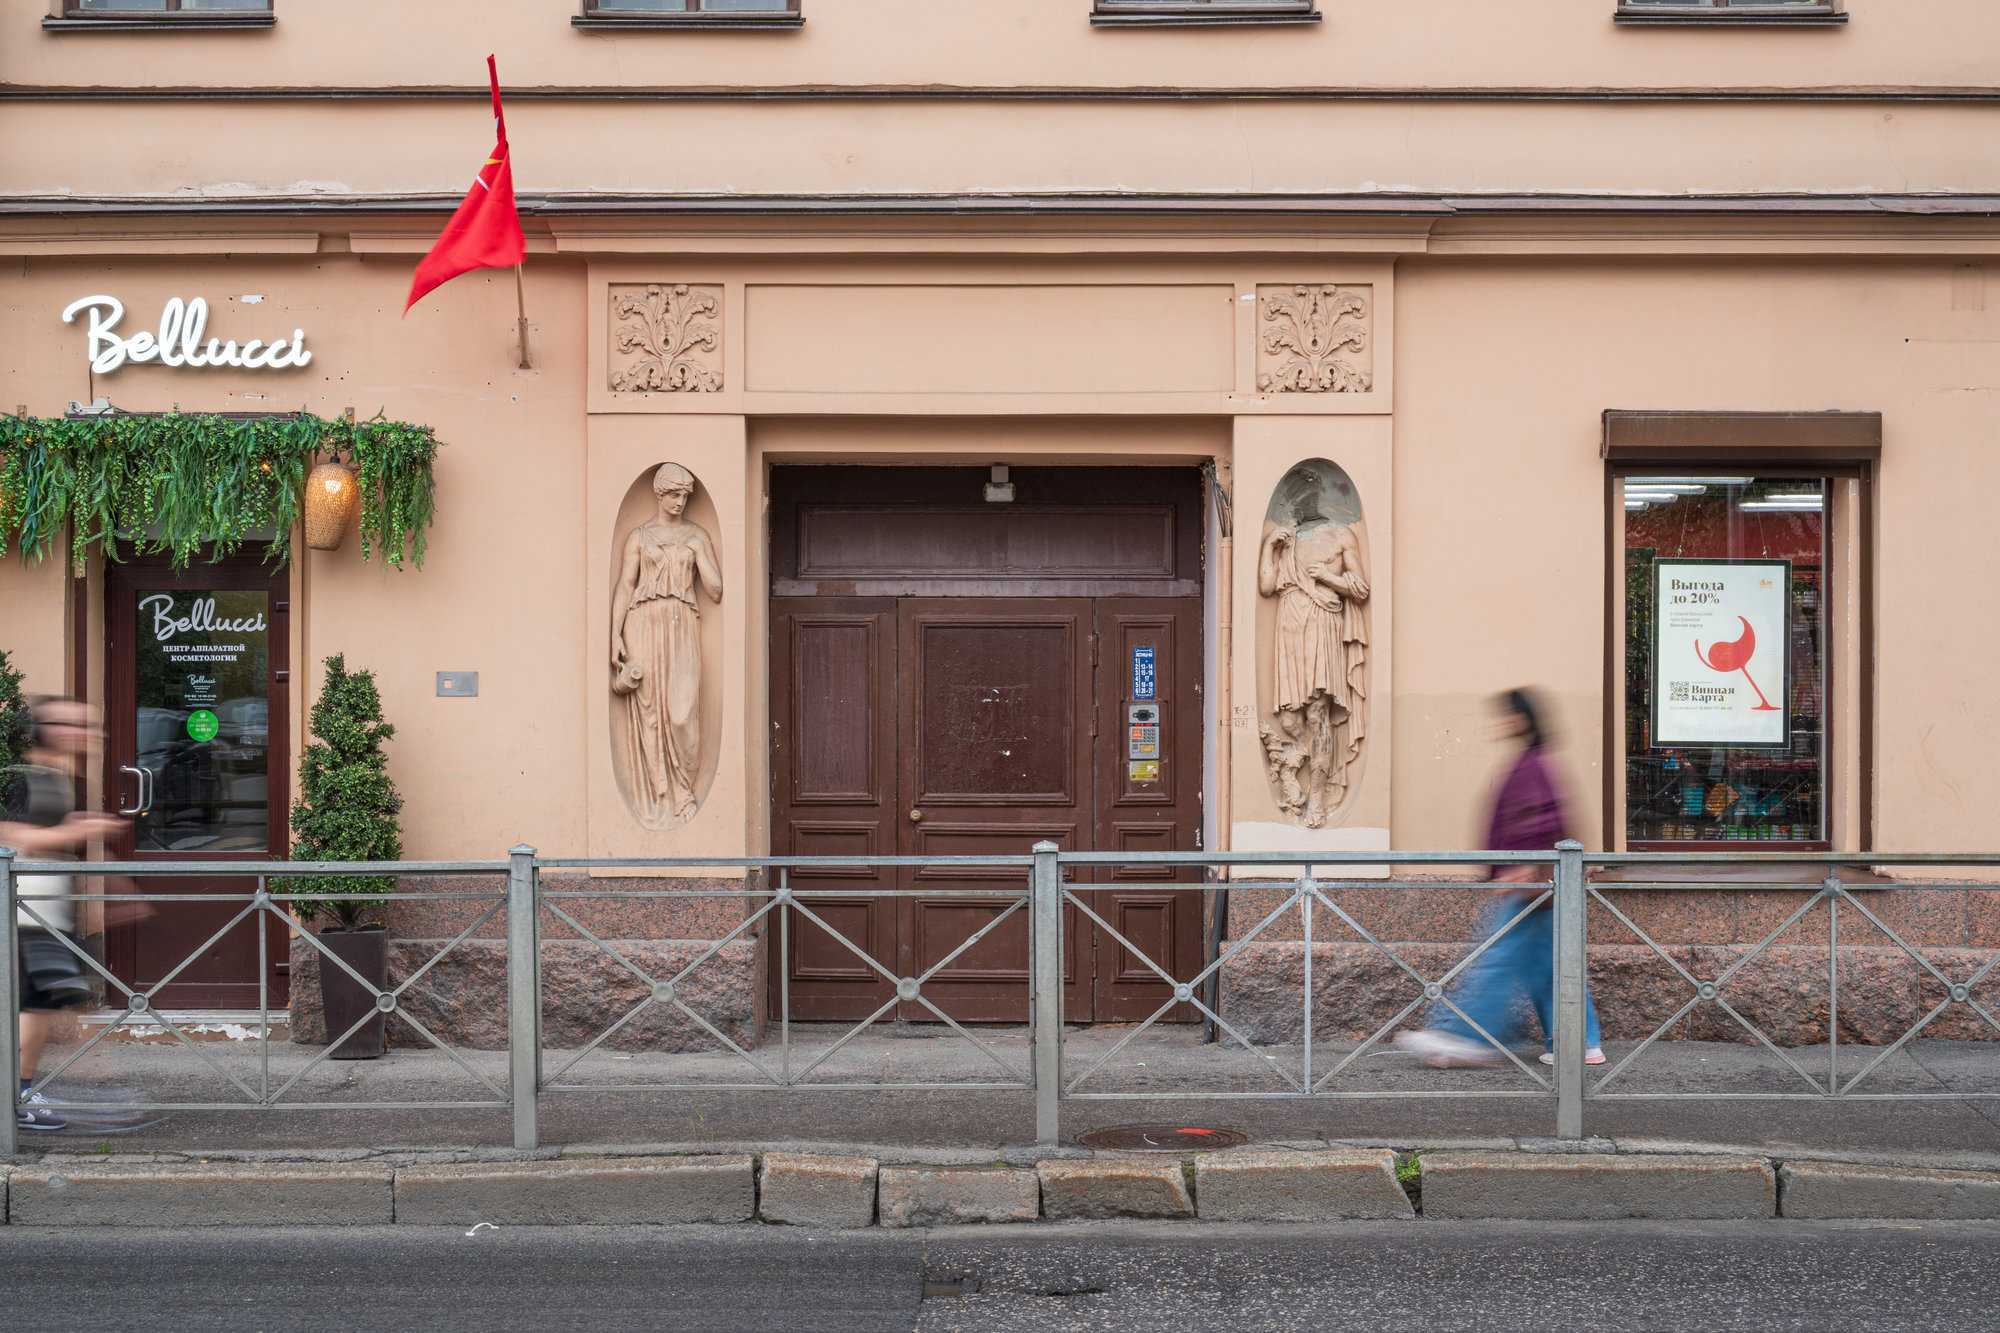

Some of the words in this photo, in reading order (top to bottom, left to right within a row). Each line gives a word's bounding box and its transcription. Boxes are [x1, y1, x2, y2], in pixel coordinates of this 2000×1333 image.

[62, 295, 312, 374] Bellucci
[1671, 579, 1725, 591] Выгода
[1670, 595, 1687, 605] до
[1690, 593, 1720, 604] 20%
[138, 594, 266, 641] Bellucci
[162, 645, 190, 653] ЦЕНТР
[191, 643, 246, 652] АППАРАТНОЙ
[170, 654, 238, 662] КОСМЕТОЛОГИИ
[1691, 685, 1735, 694] Винная
[1691, 694, 1725, 704] карта
